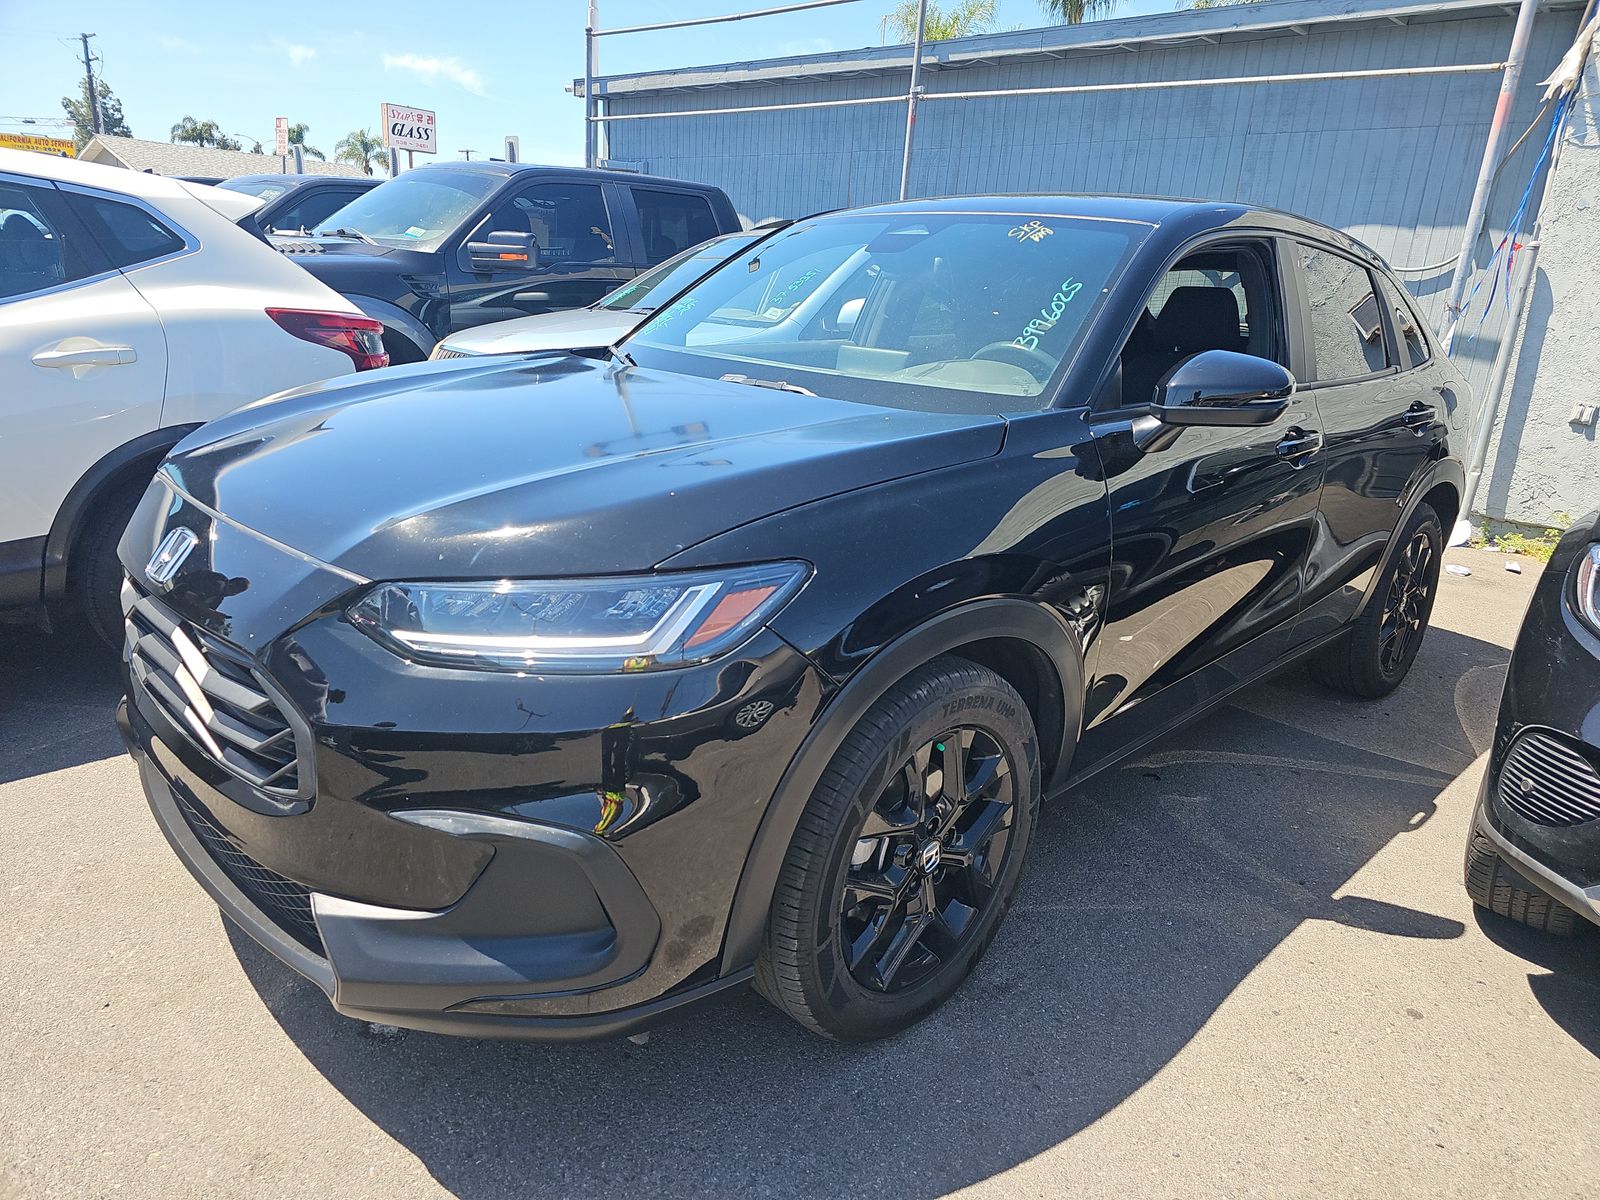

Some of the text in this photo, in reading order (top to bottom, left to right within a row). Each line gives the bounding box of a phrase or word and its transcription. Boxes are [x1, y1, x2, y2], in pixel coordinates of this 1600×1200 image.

[391, 109, 415, 122] STAR'S
[391, 122, 433, 141] GLASS
[34, 137, 49, 147] AUTO
[51, 139, 74, 149] SERVICE
[943, 695, 995, 718] TERRENA
